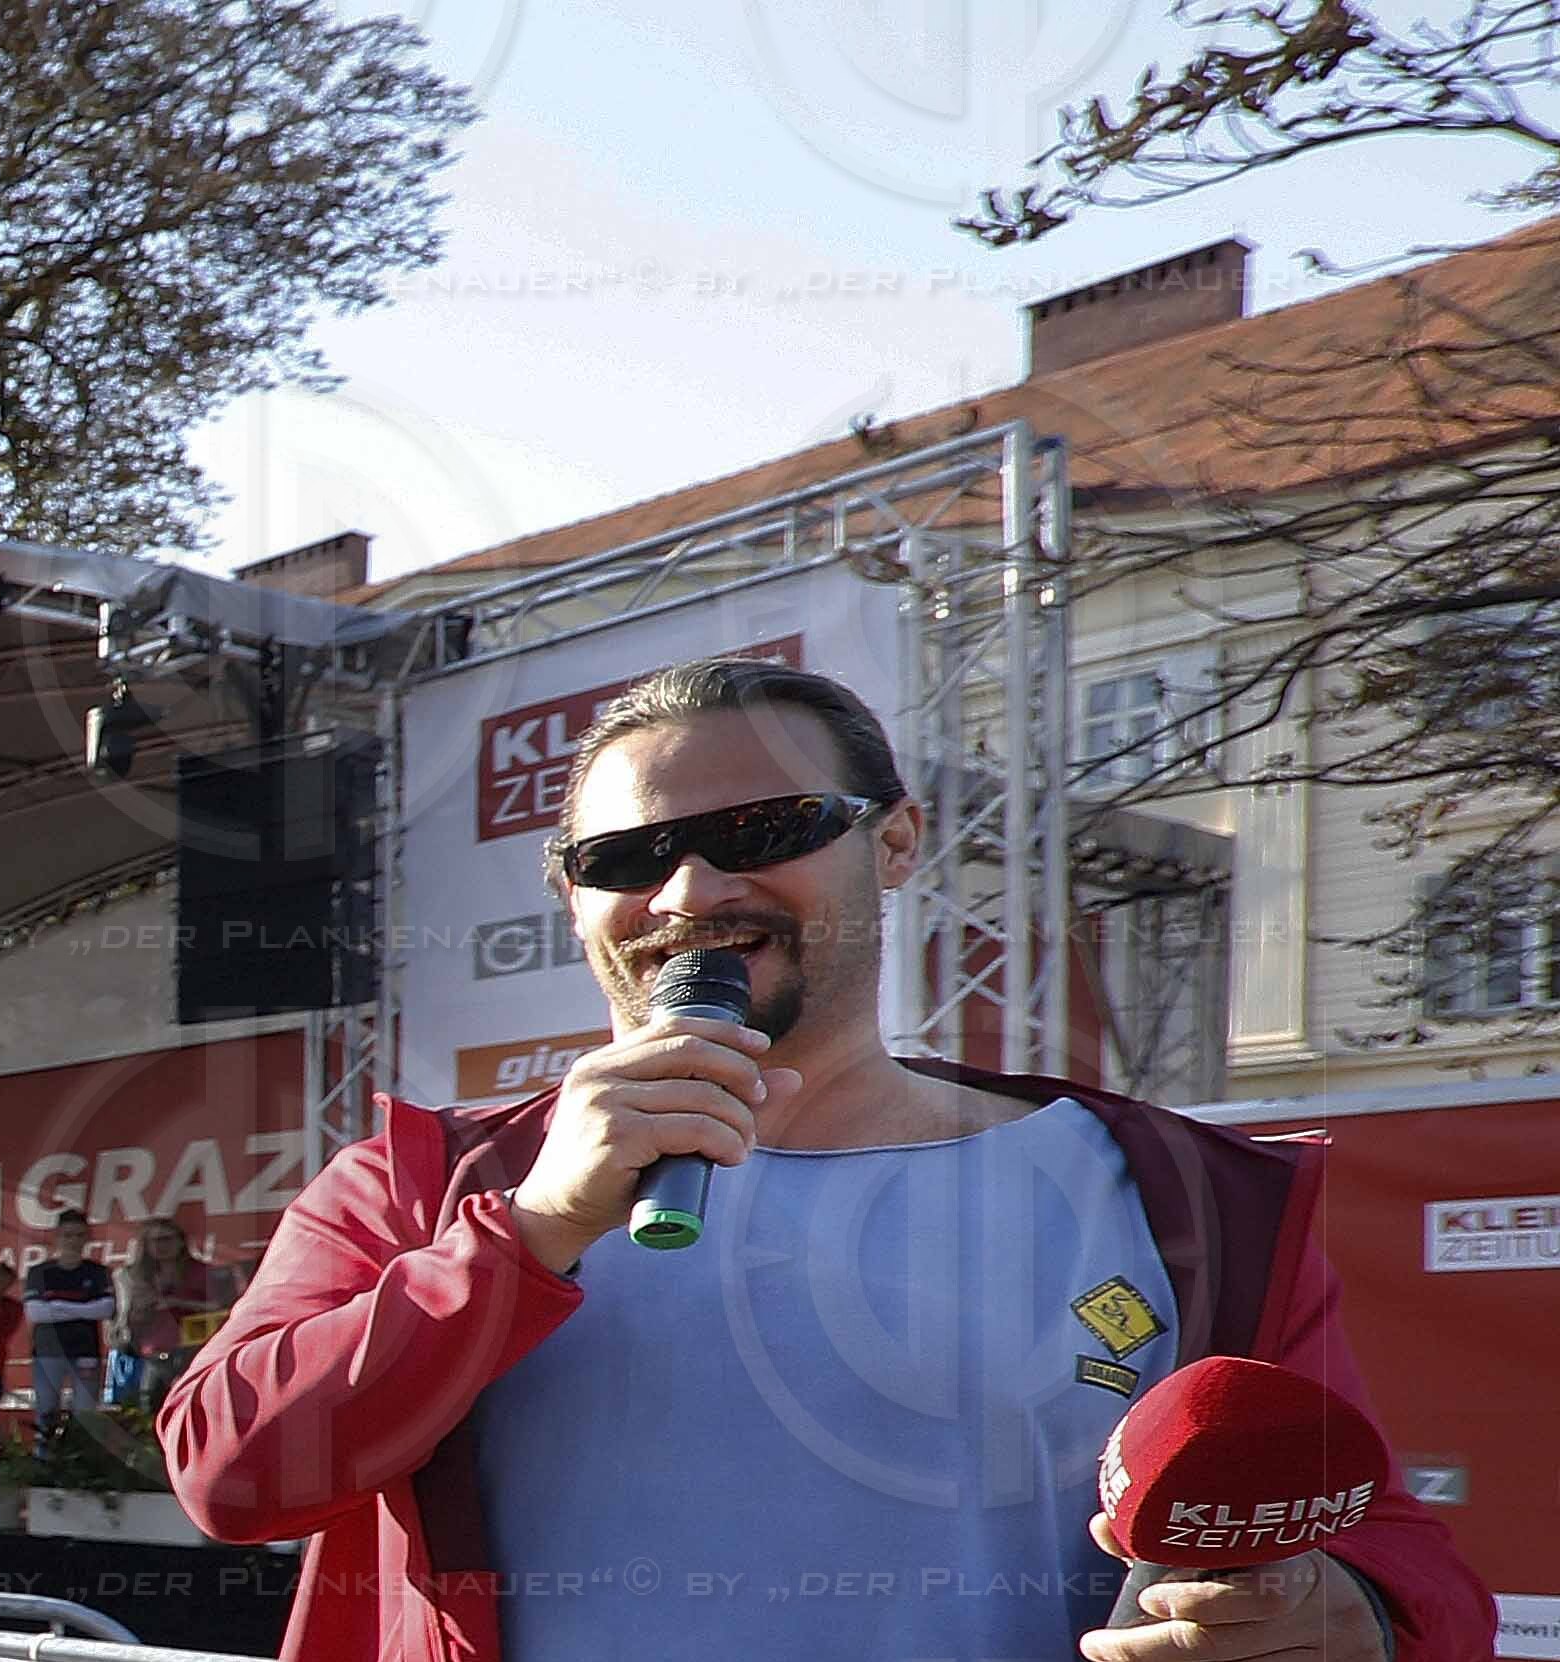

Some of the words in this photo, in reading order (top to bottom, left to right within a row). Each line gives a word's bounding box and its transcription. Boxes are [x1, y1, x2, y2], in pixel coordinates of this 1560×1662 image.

[16, 1130, 307, 1230] GRAZ
[1438, 1206, 1560, 1233] KLEI
[1159, 1504, 1367, 1548] ZEITUNG
[1170, 1480, 1376, 1528] KLEINE
